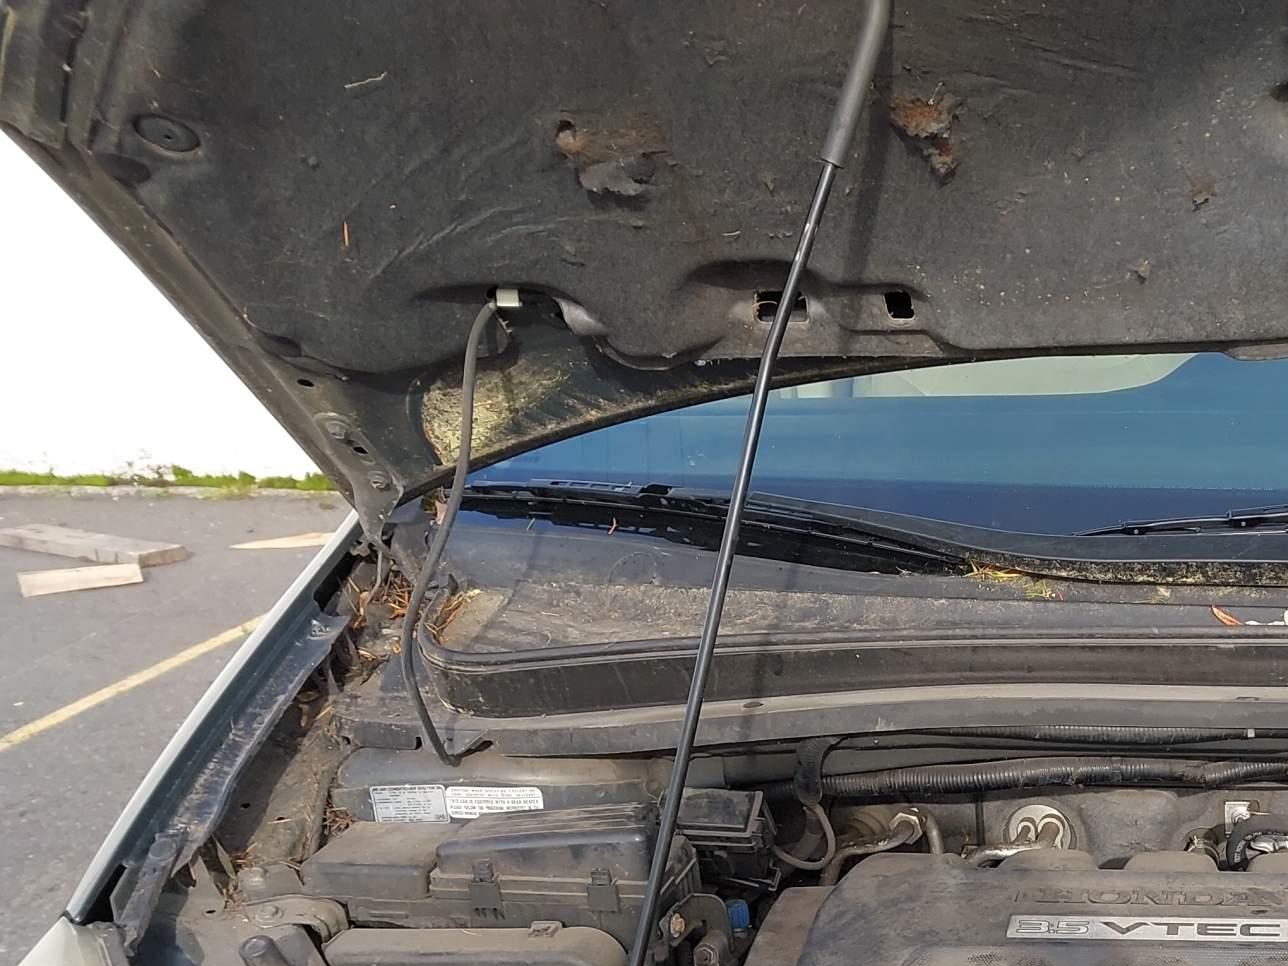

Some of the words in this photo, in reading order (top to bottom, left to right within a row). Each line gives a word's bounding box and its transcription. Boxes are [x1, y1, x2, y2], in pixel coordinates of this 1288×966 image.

[1032, 887, 1282, 906] HONDA
[1015, 919, 1090, 934] 3.5
[1099, 921, 1281, 937] VTEC
